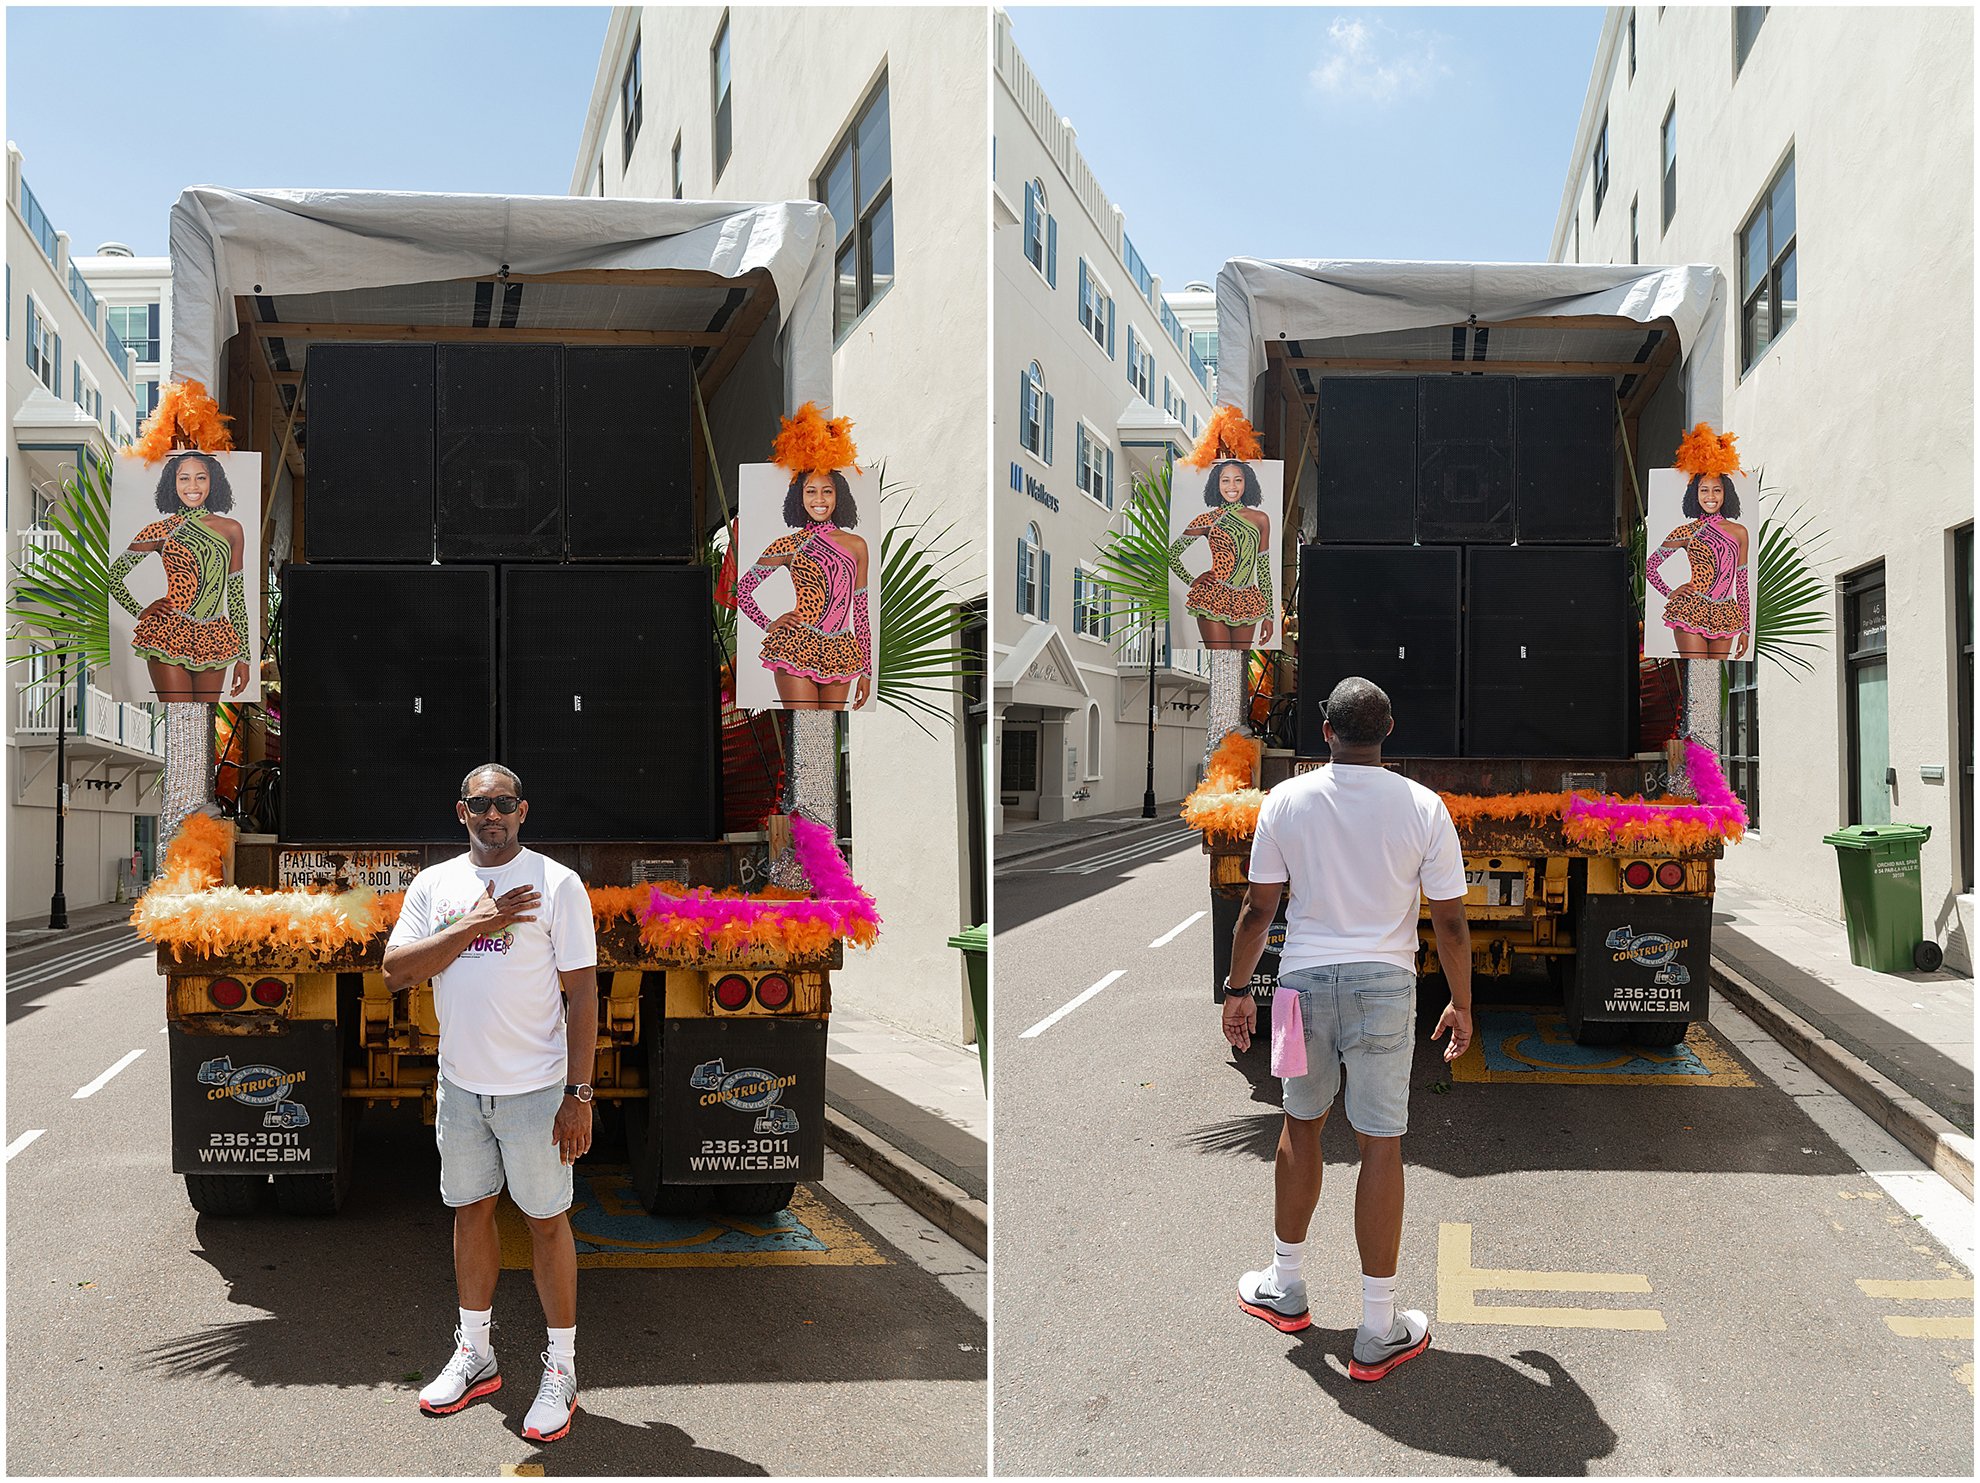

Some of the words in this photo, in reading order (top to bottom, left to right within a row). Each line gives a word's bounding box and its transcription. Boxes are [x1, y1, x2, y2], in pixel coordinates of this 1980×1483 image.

[1026, 474, 1059, 513] Walkers
[1489, 872, 1523, 906] T
[1613, 939, 1688, 962] CONSTRUCTION
[1605, 1000, 1690, 1012] WWW.ICS.BM
[207, 1071, 306, 1101] CONSTRUCTION
[699, 1075, 797, 1107] CONSTRUCTION
[199, 1148, 311, 1162] WWW.ICS.BM
[690, 1155, 799, 1171] WWW.ICS.BM
